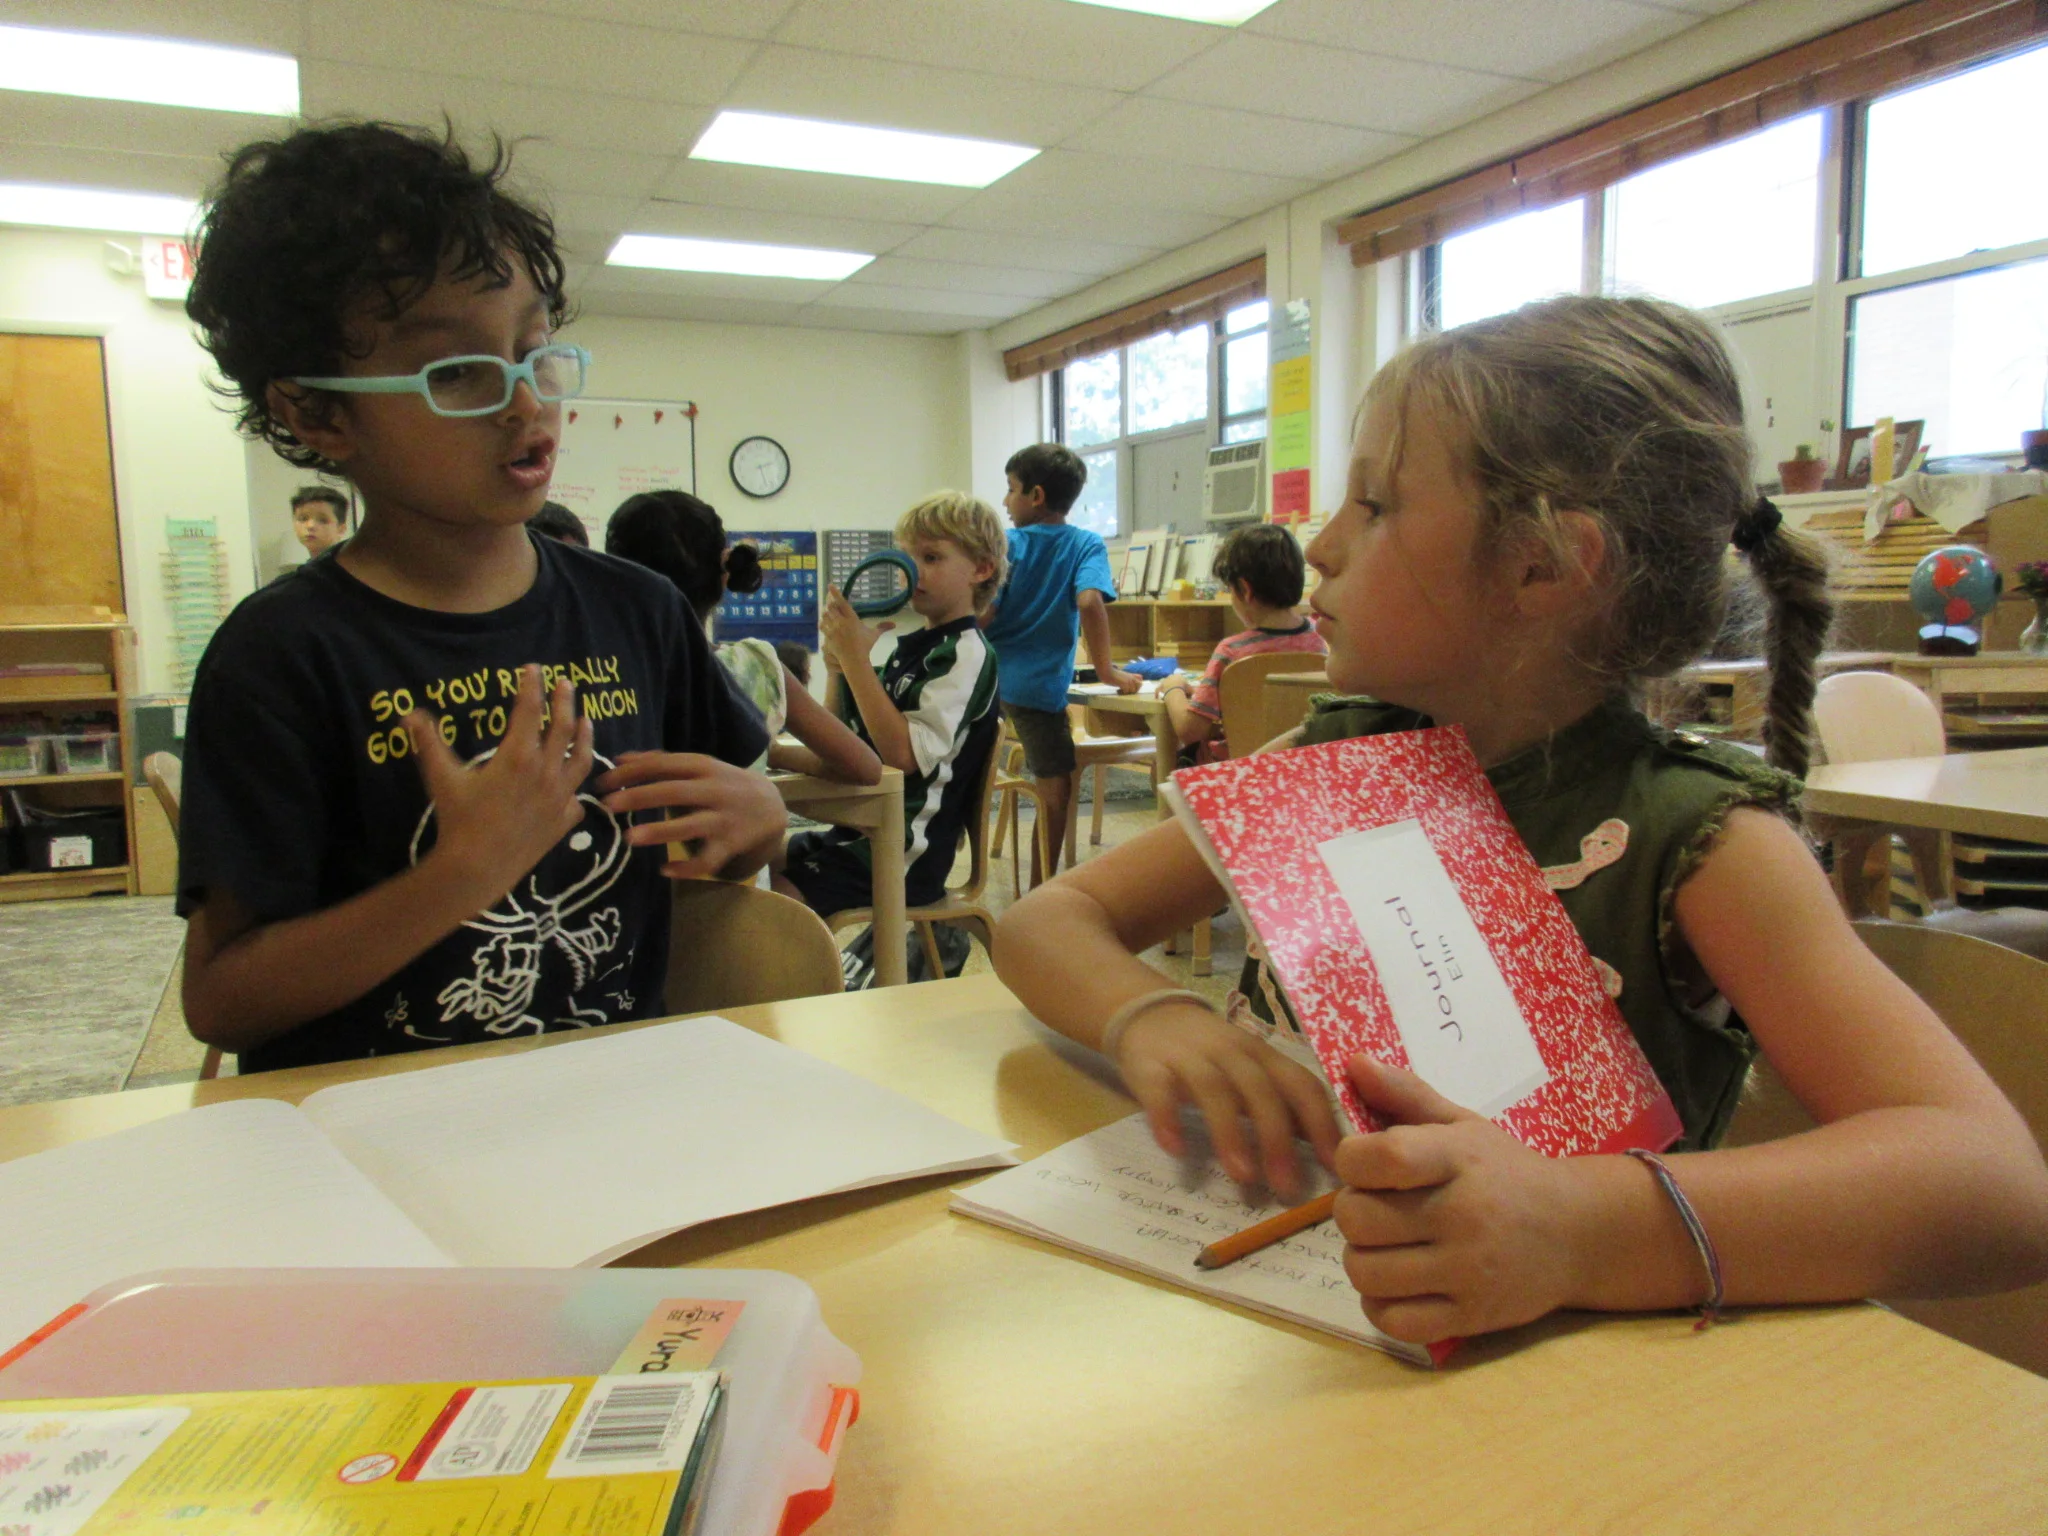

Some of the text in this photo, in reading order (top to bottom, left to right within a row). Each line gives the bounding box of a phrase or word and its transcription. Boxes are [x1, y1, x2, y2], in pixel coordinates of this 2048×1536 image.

[732, 606, 740, 616] 11
[746, 606, 755, 616] 12
[761, 606, 770, 616] 13
[779, 605, 788, 615] 14
[792, 605, 801, 615] 15
[370, 688, 415, 722] SO
[541, 655, 621, 694] REALLY
[367, 714, 457, 764] GOIG
[469, 705, 507, 740] TO
[582, 687, 639, 721] MOON
[1384, 896, 1463, 1042] Journal
[640, 1328, 703, 1374] Yura
